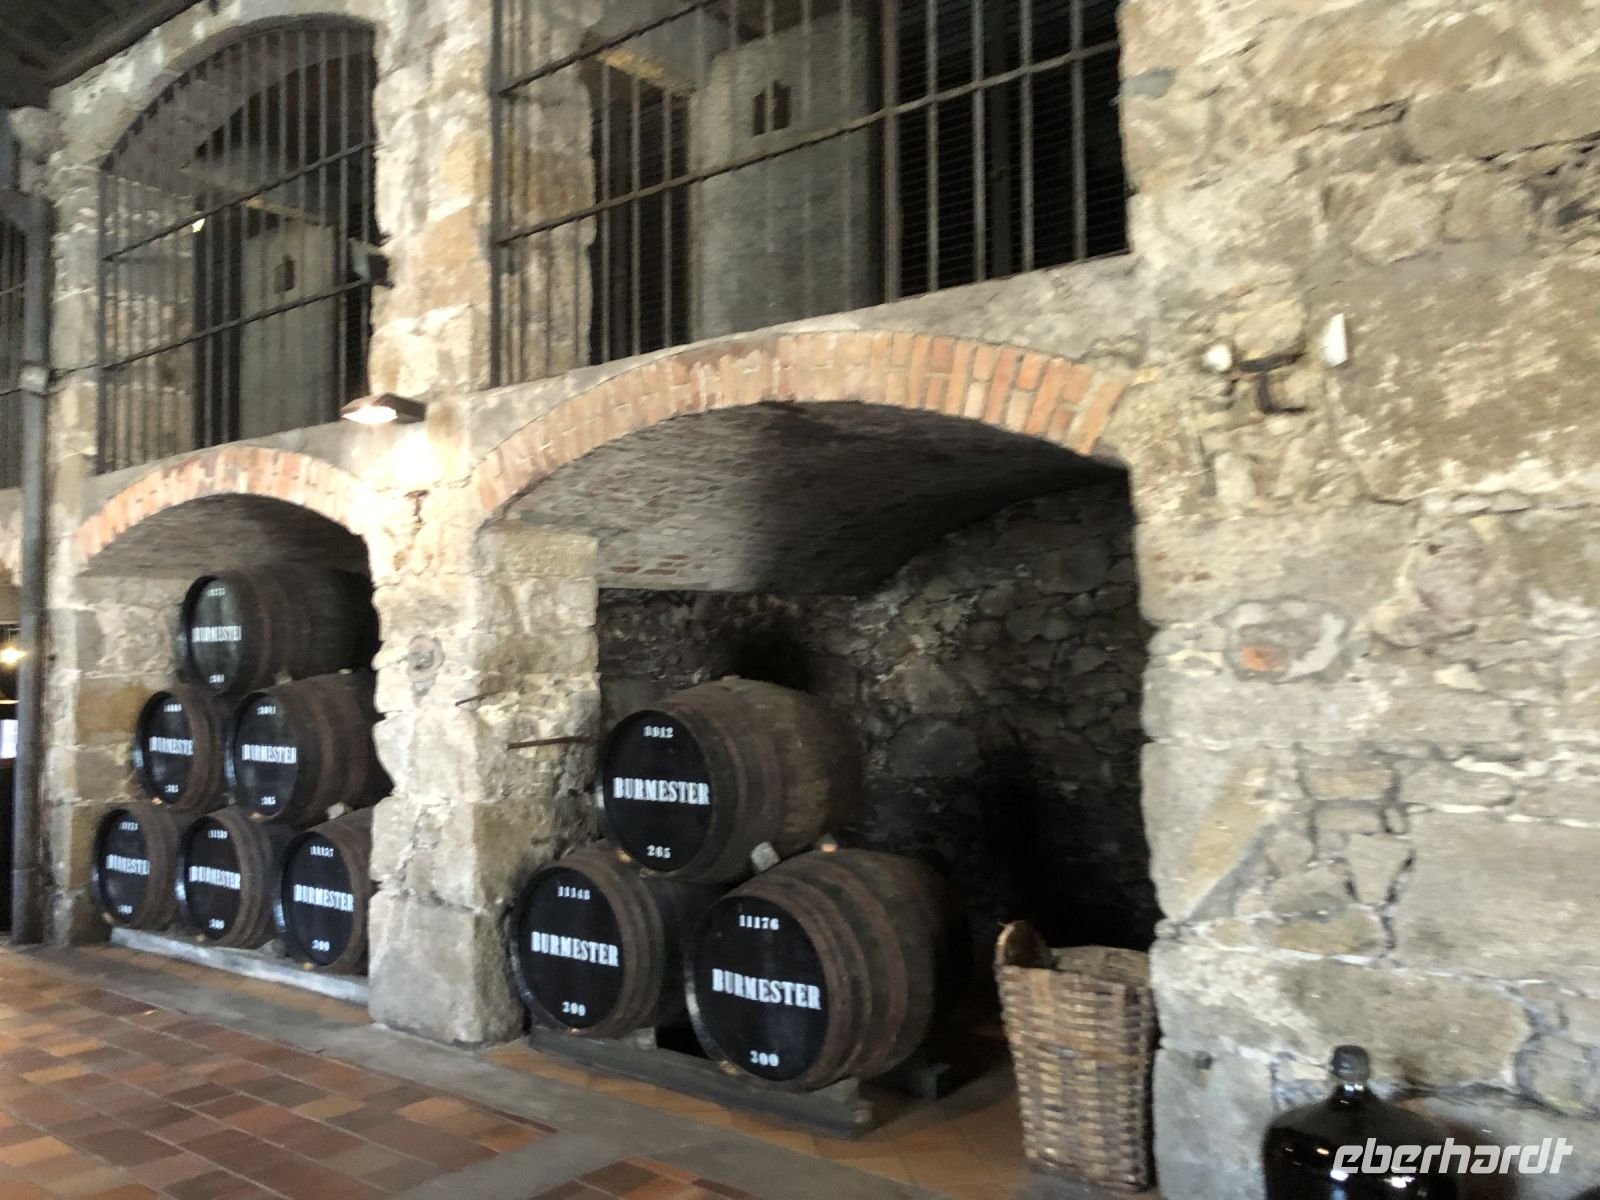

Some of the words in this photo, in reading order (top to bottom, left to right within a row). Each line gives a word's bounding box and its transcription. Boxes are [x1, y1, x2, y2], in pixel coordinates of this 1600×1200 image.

[613, 777, 710, 805] BURMESTER
[106, 854, 150, 875] BURMESTE
[294, 884, 354, 912] BURMESTER
[739, 914, 780, 931] 11176
[531, 931, 619, 967] BURMESTER
[712, 968, 822, 1010] BURMESTER
